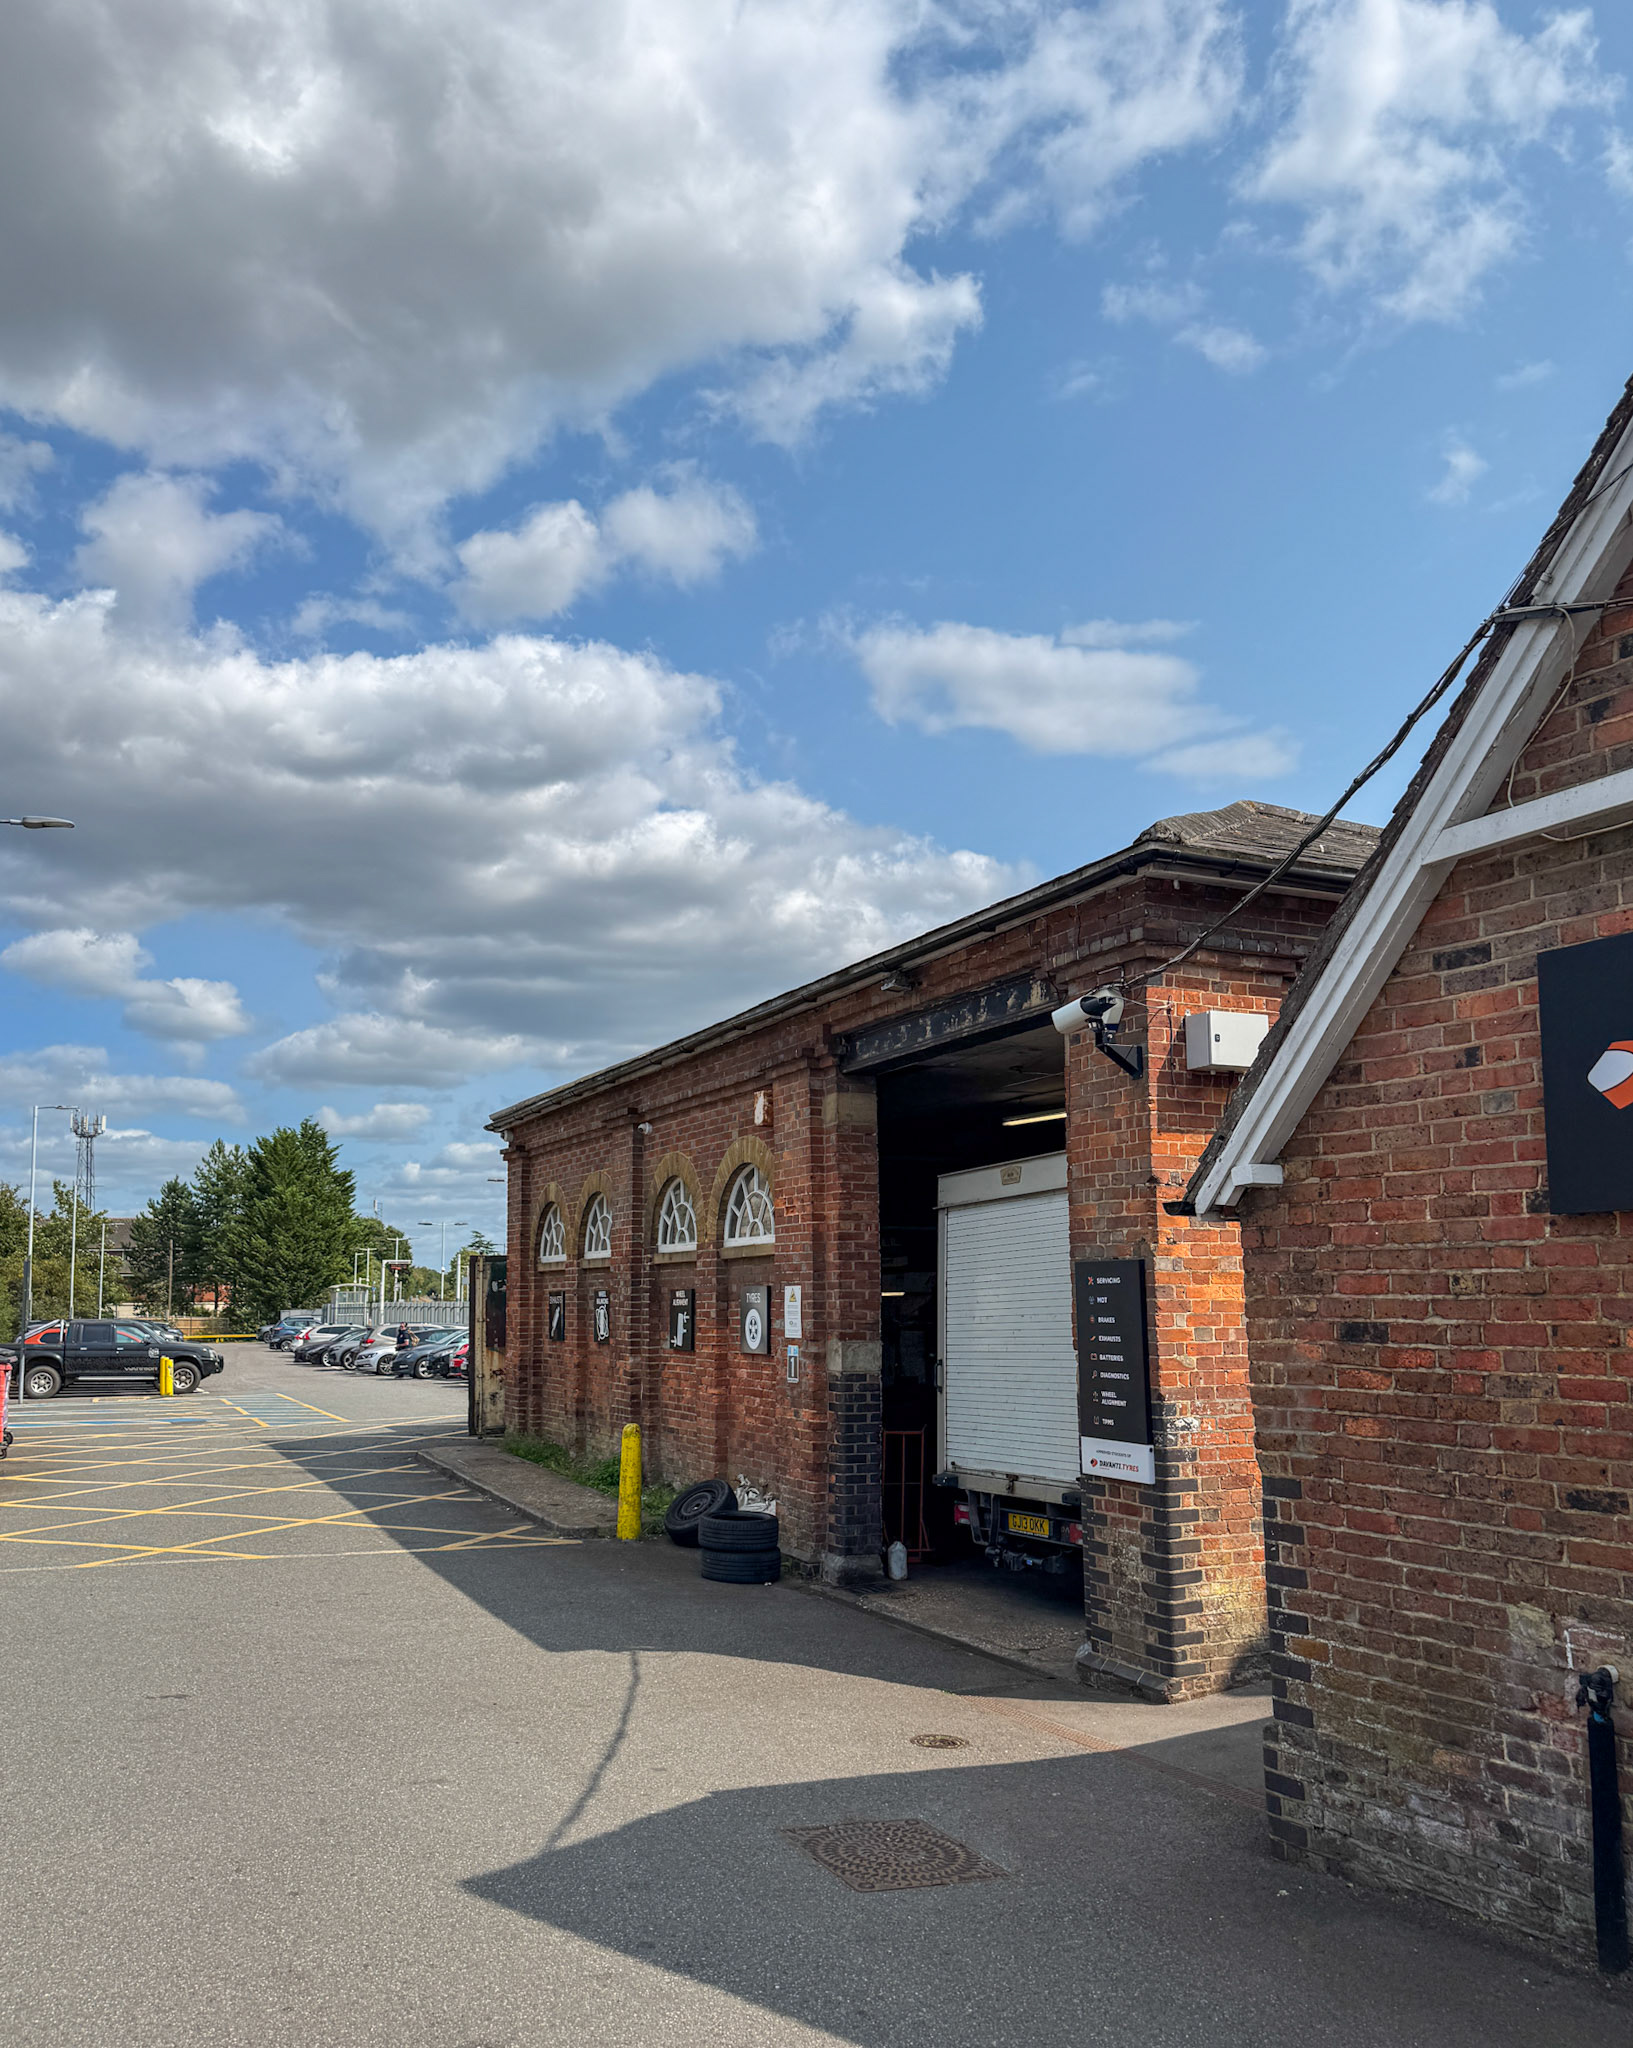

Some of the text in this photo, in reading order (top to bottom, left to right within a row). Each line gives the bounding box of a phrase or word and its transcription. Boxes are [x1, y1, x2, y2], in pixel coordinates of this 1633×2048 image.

[746, 1292, 761, 1303] TYRES
[1096, 1296, 1108, 1304] MOT
[1097, 1316, 1116, 1324] BRAKES
[1098, 1335, 1122, 1343] EXHAUSTS
[1099, 1353, 1124, 1362] BATTERIES
[790, 1356, 795, 1378] 1
[1100, 1371, 1130, 1380] DIAGNOSTICS
[1101, 1390, 1117, 1398] WHEEL
[1101, 1398, 1127, 1407] ALIGNMENT
[1102, 1418, 1115, 1426] TPMS
[1012, 1515, 1027, 1530] GJ13
[1029, 1518, 1045, 1533] OKK
